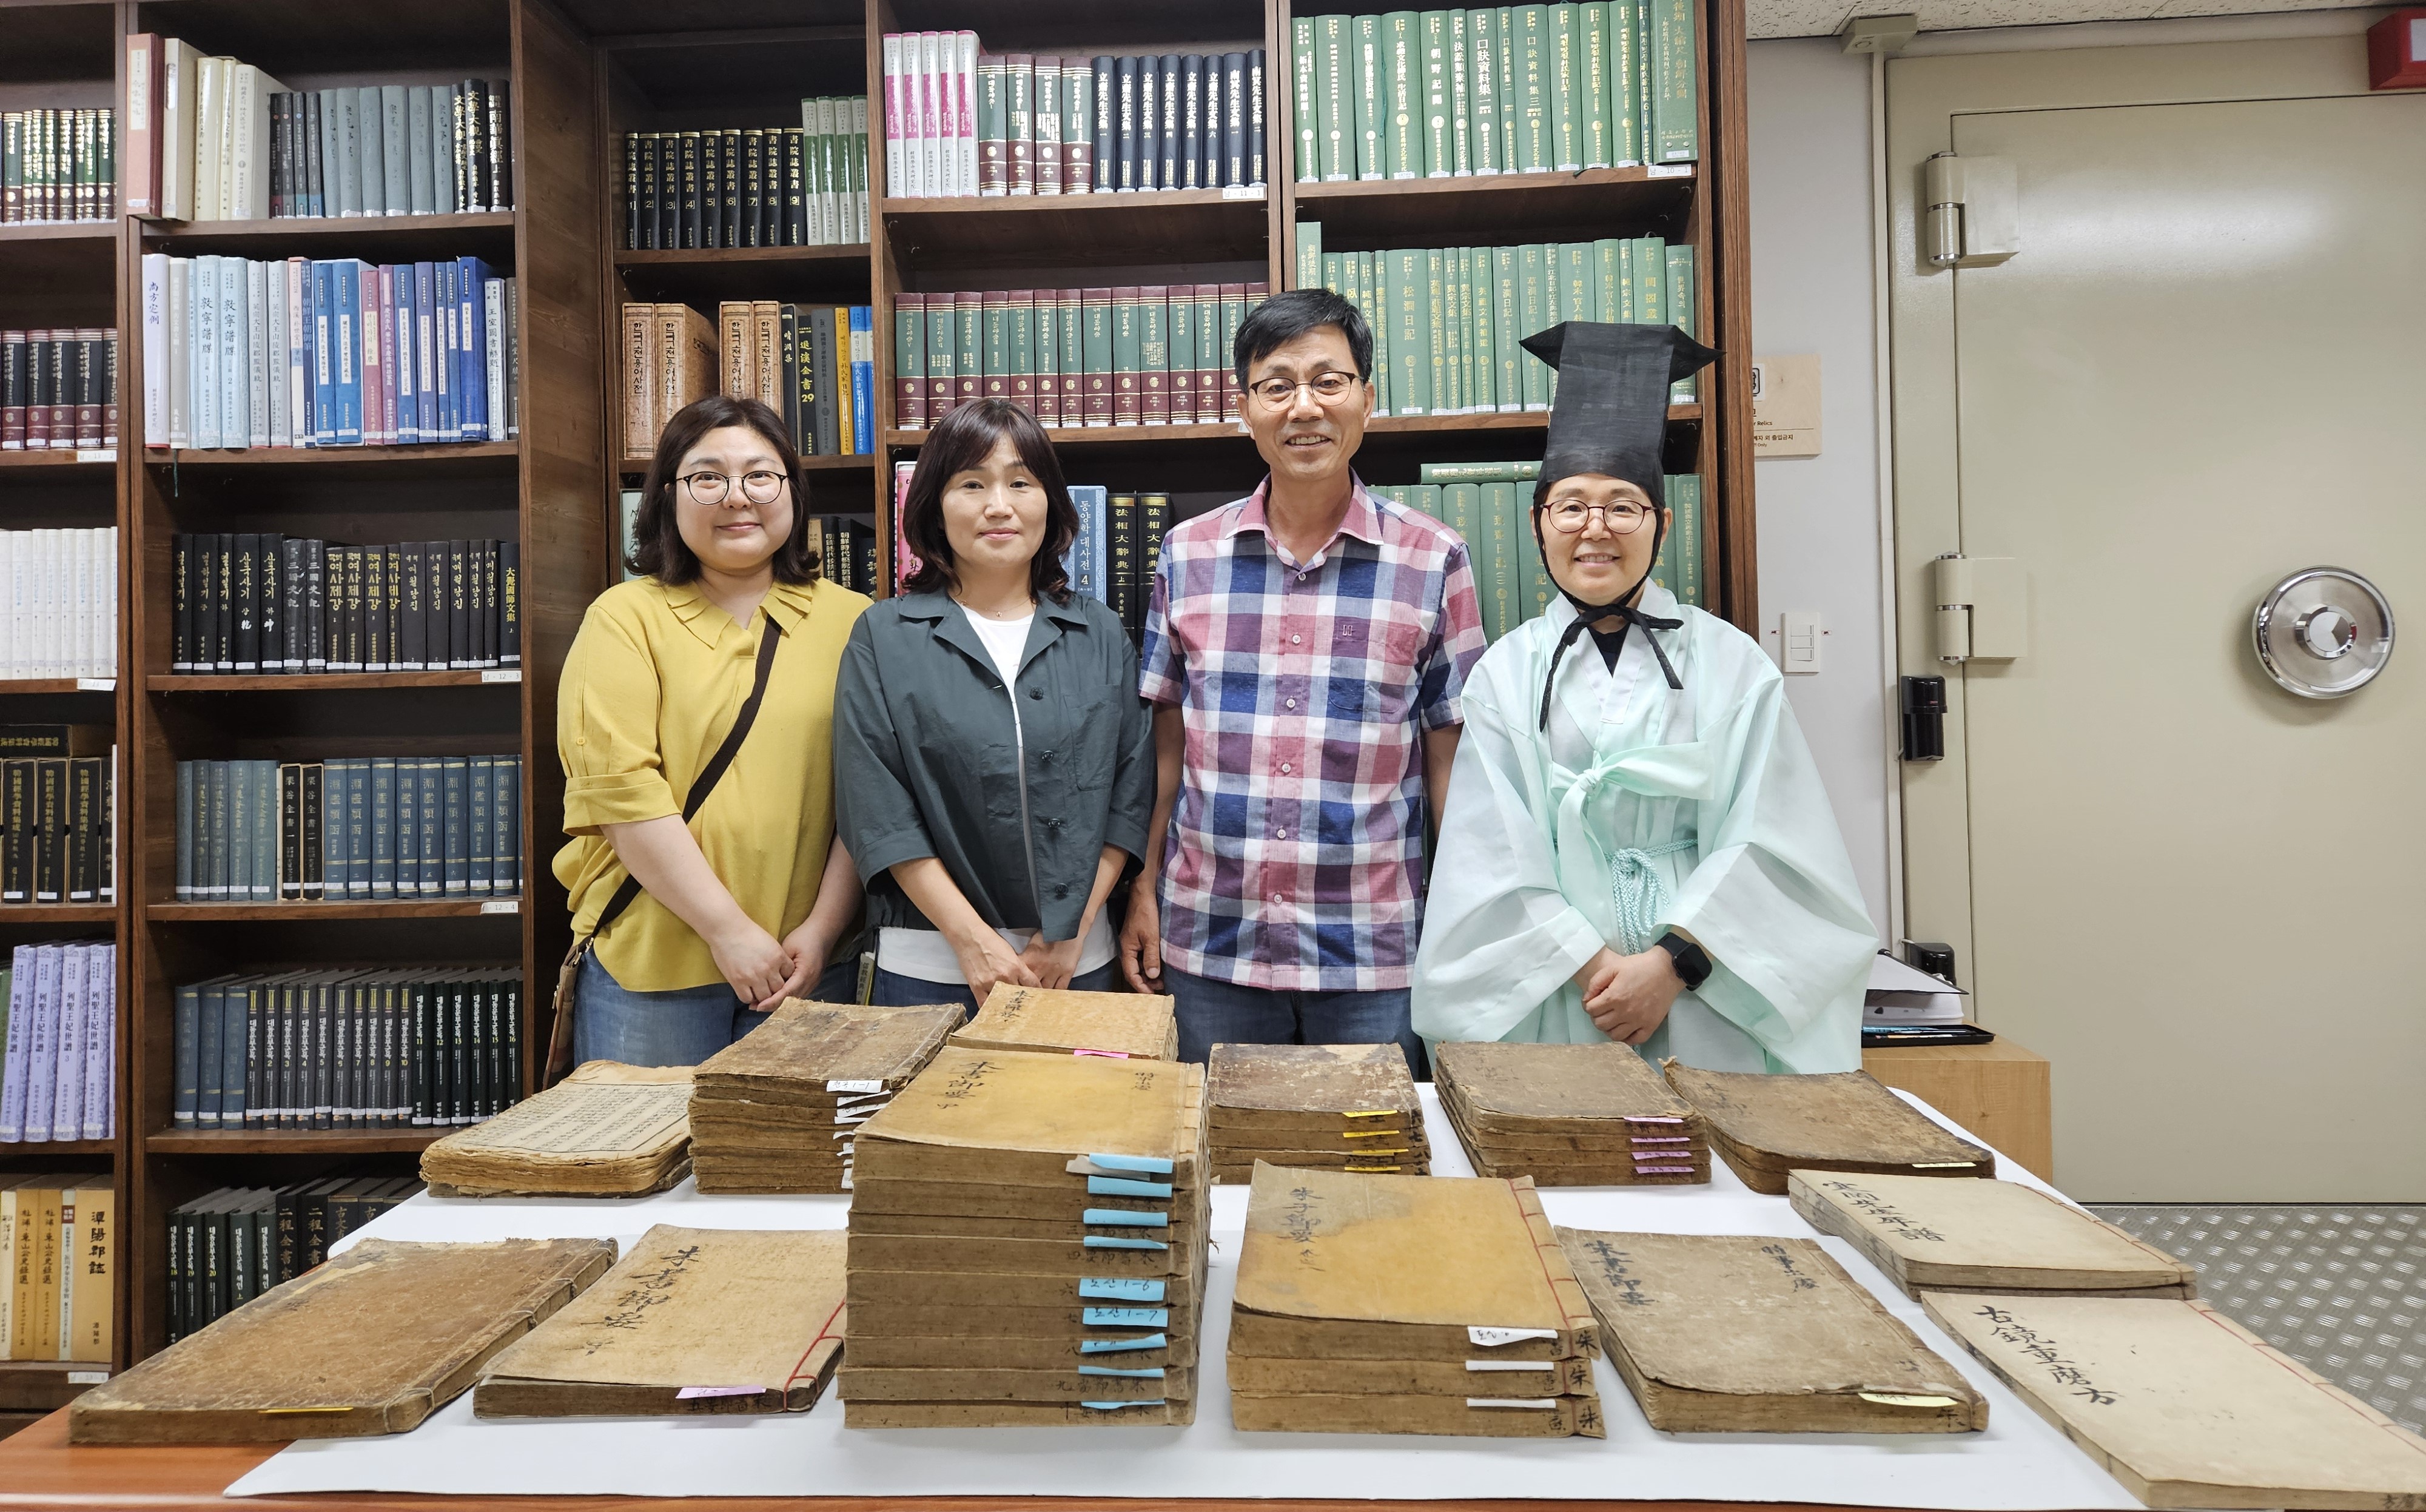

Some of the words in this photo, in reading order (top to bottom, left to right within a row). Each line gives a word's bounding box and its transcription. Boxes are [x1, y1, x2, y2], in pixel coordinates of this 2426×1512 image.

[633, 323, 643, 394] 한국고전용어사전
[665, 323, 675, 394] 한국고전용어사전
[731, 322, 741, 393] 한국고전용어사전
[761, 321, 771, 393] 한국고전용어사전
[802, 394, 815, 402] 29
[240, 552, 251, 599] 삼국사기
[264, 552, 276, 599] 삼국사기
[329, 562, 344, 611] 여사제강
[348, 562, 361, 610] 여사제강
[368, 562, 381, 610] 여사제강
[1081, 576, 1089, 584] 4
[1973, 1305, 2119, 1405] 古鏡重磨方
